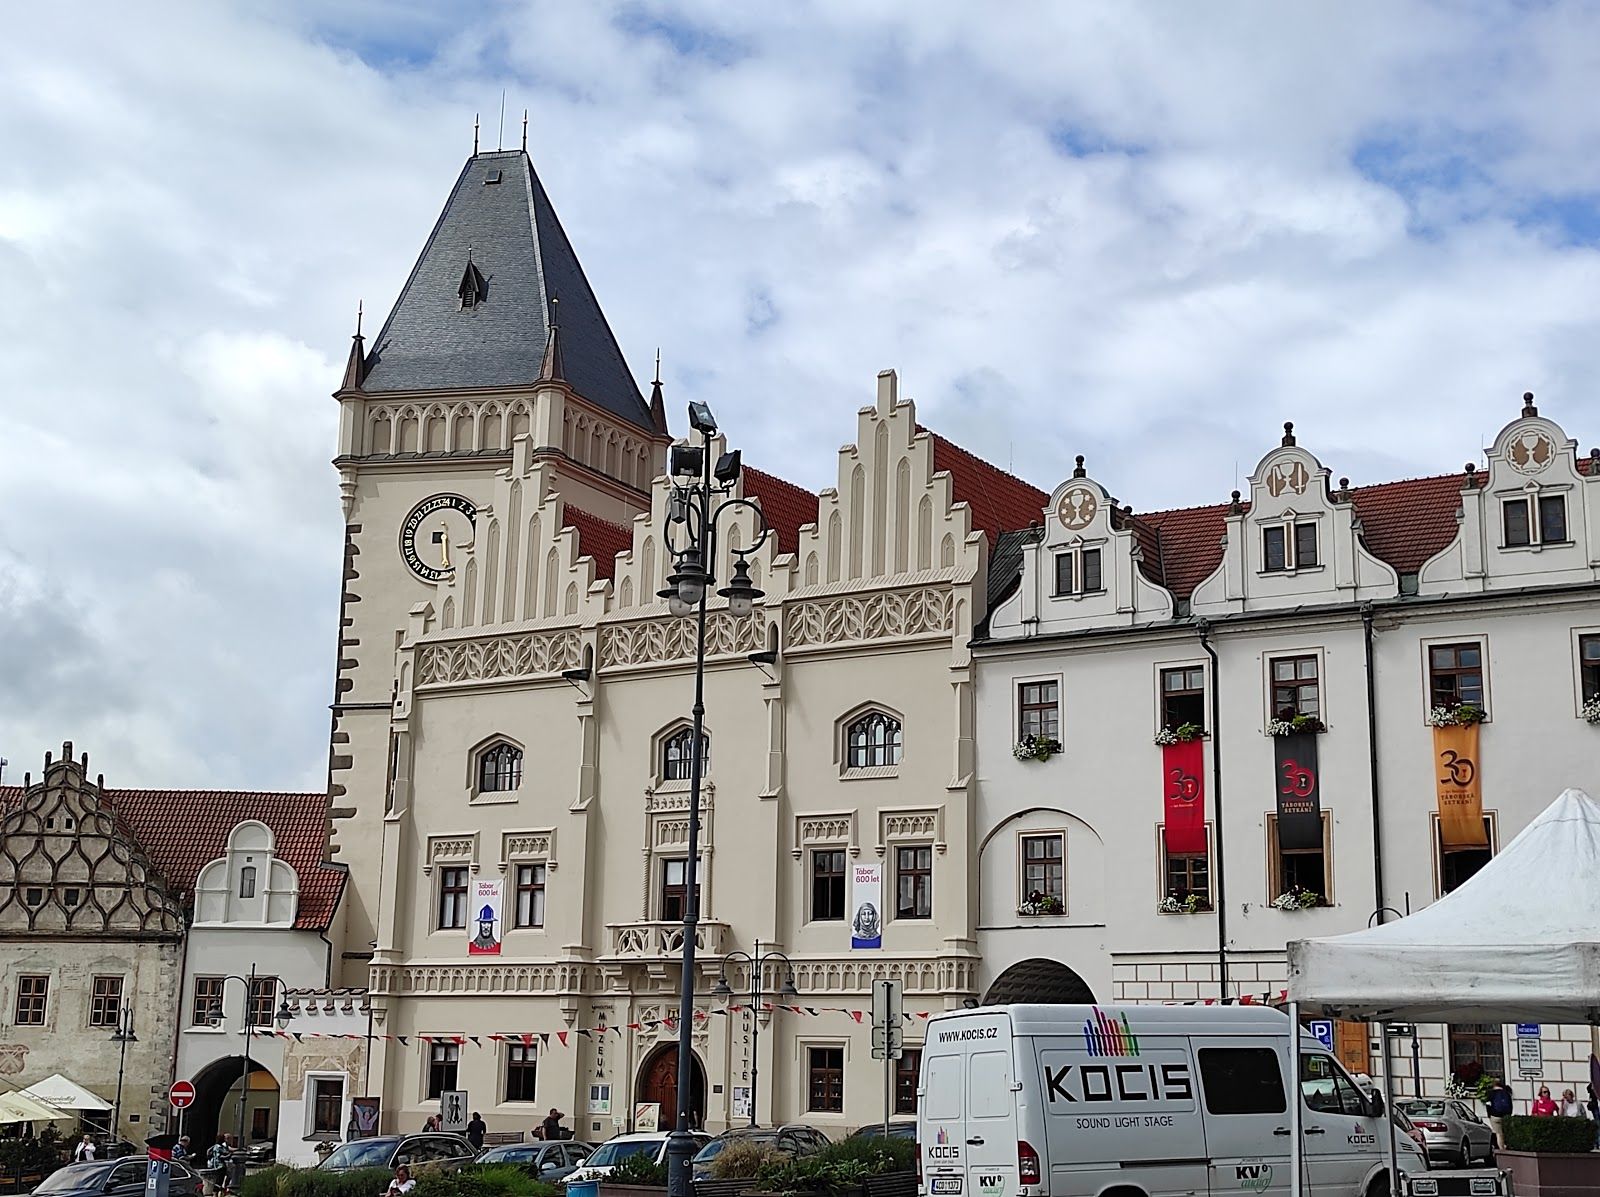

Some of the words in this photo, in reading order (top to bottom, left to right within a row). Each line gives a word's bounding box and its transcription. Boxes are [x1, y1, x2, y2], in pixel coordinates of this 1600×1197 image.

[421, 503, 432, 514] 22
[432, 500, 442, 508] 23
[414, 511, 424, 520] 21
[408, 518, 418, 529] 20
[405, 529, 413, 538] 19
[1440, 750, 1474, 787] 30
[1281, 760, 1314, 796] 30
[1170, 768, 1200, 802] 30
[939, 1028, 997, 1042] WWW.KOCIS.CZ
[1315, 1025, 1327, 1039] P
[1045, 1065, 1193, 1102] KOCIS
[1076, 1118, 1110, 1129] SOUND
[1115, 1117, 1140, 1128] LIGHT
[1144, 1116, 1174, 1127] STAGE
[1348, 1135, 1375, 1144] KOCIS
[929, 1147, 959, 1158] KOCIS
